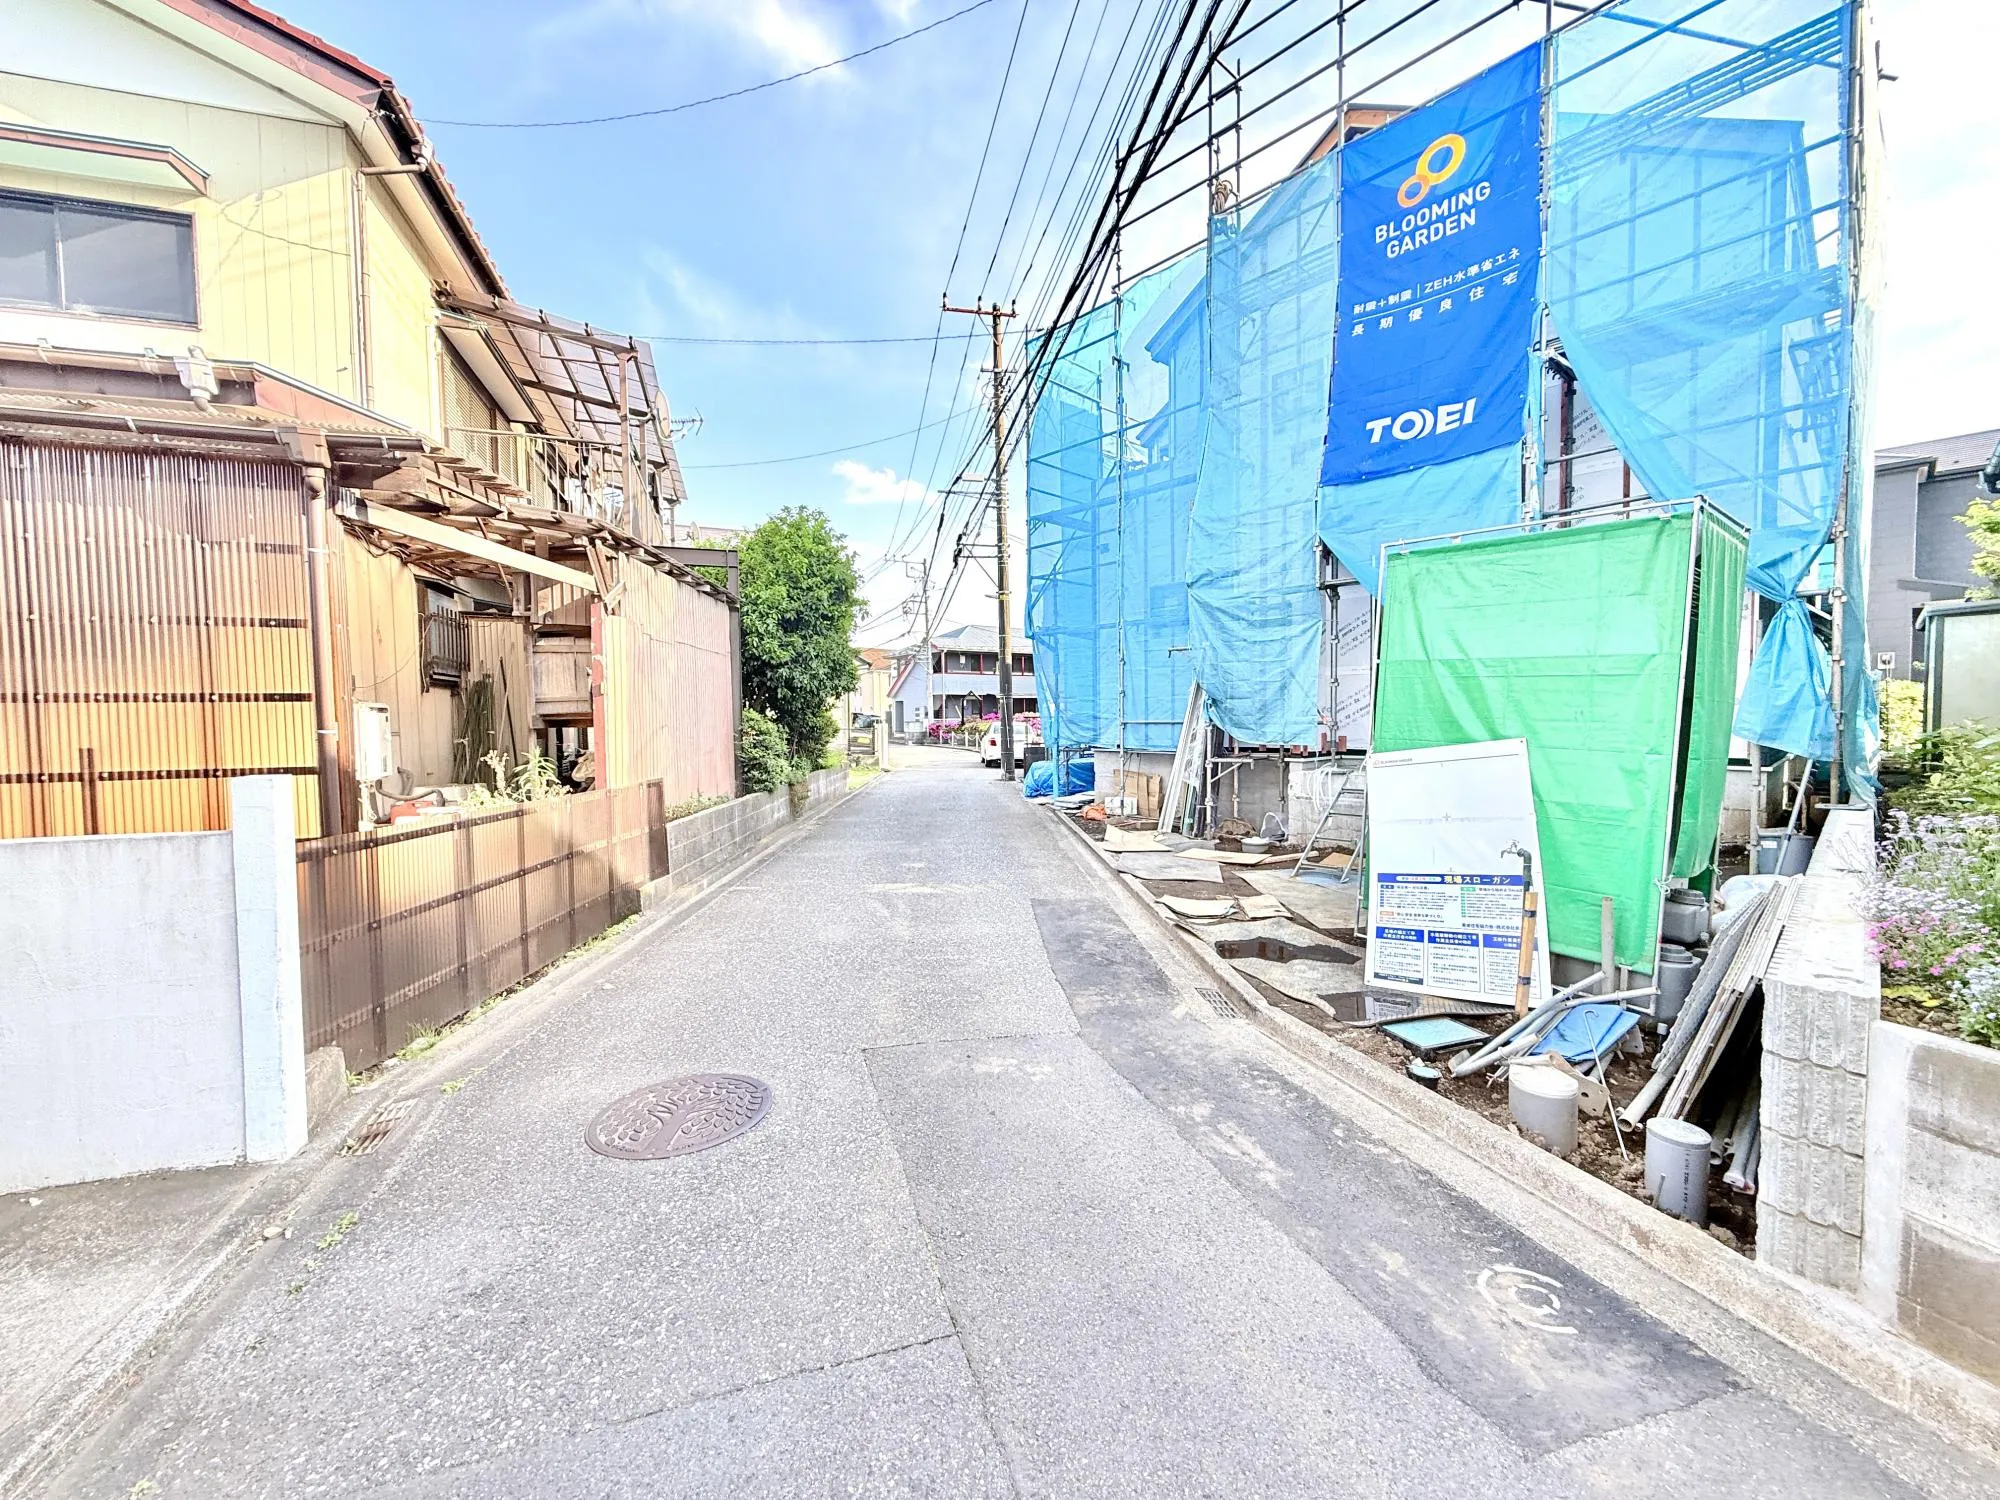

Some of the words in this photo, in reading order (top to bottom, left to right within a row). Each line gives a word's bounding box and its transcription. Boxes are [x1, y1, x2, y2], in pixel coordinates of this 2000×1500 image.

[1375, 181, 1491, 244] BLOOMING
[1386, 207, 1476, 258] GARDEN
[1351, 270, 1519, 337] 長期優良住宅
[1365, 397, 1477, 444] TOEI
[1443, 875, 1511, 885] 現場スローガン
